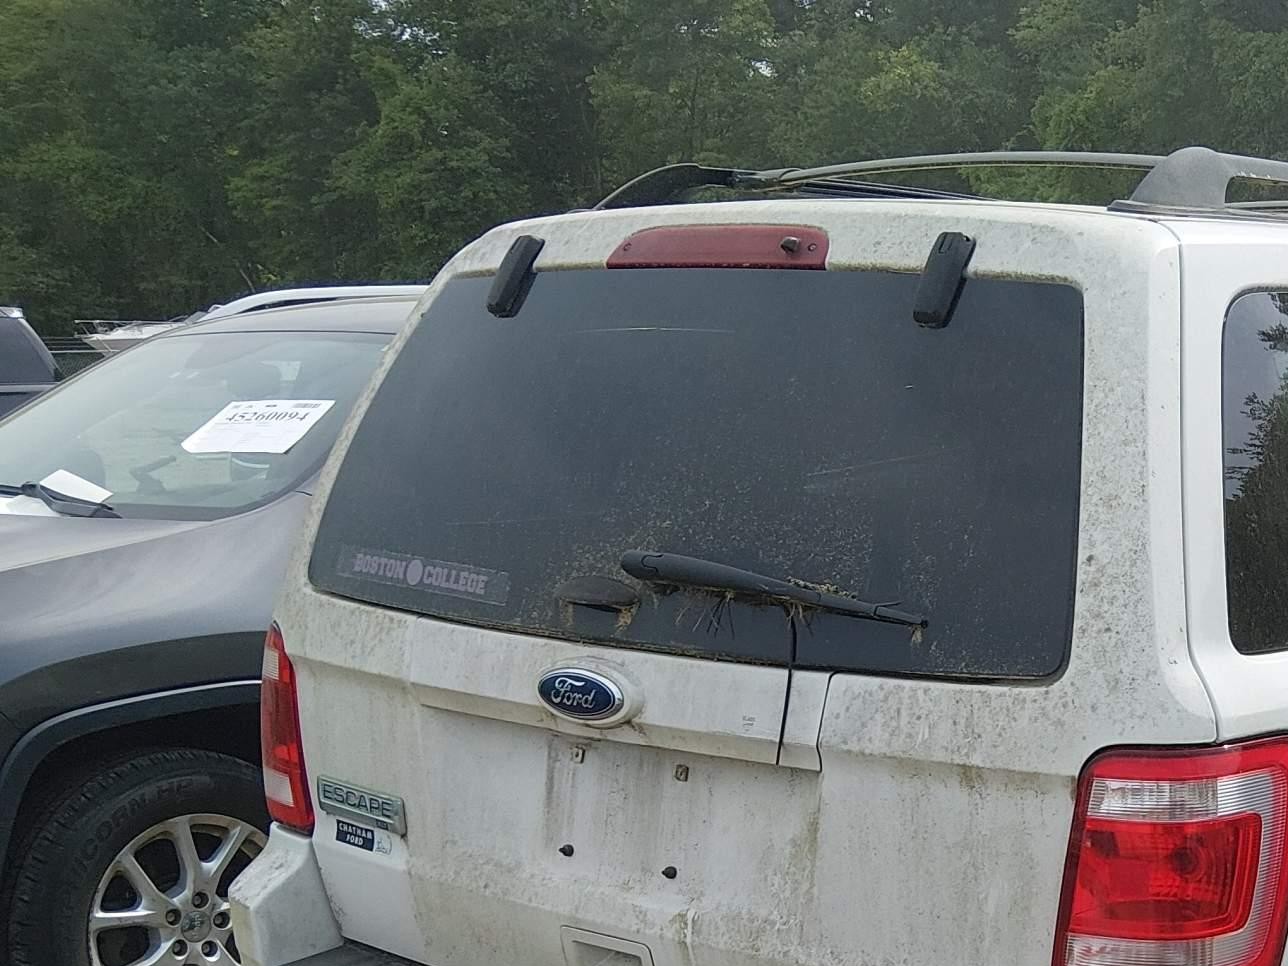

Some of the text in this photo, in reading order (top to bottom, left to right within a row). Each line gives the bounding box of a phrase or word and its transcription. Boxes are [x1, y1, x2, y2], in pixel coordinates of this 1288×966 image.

[352, 553, 489, 595] BOSTON COLLEGE
[551, 677, 597, 709] Ford
[323, 783, 393, 819] ESCAPE
[339, 822, 373, 840] CHATHAM
